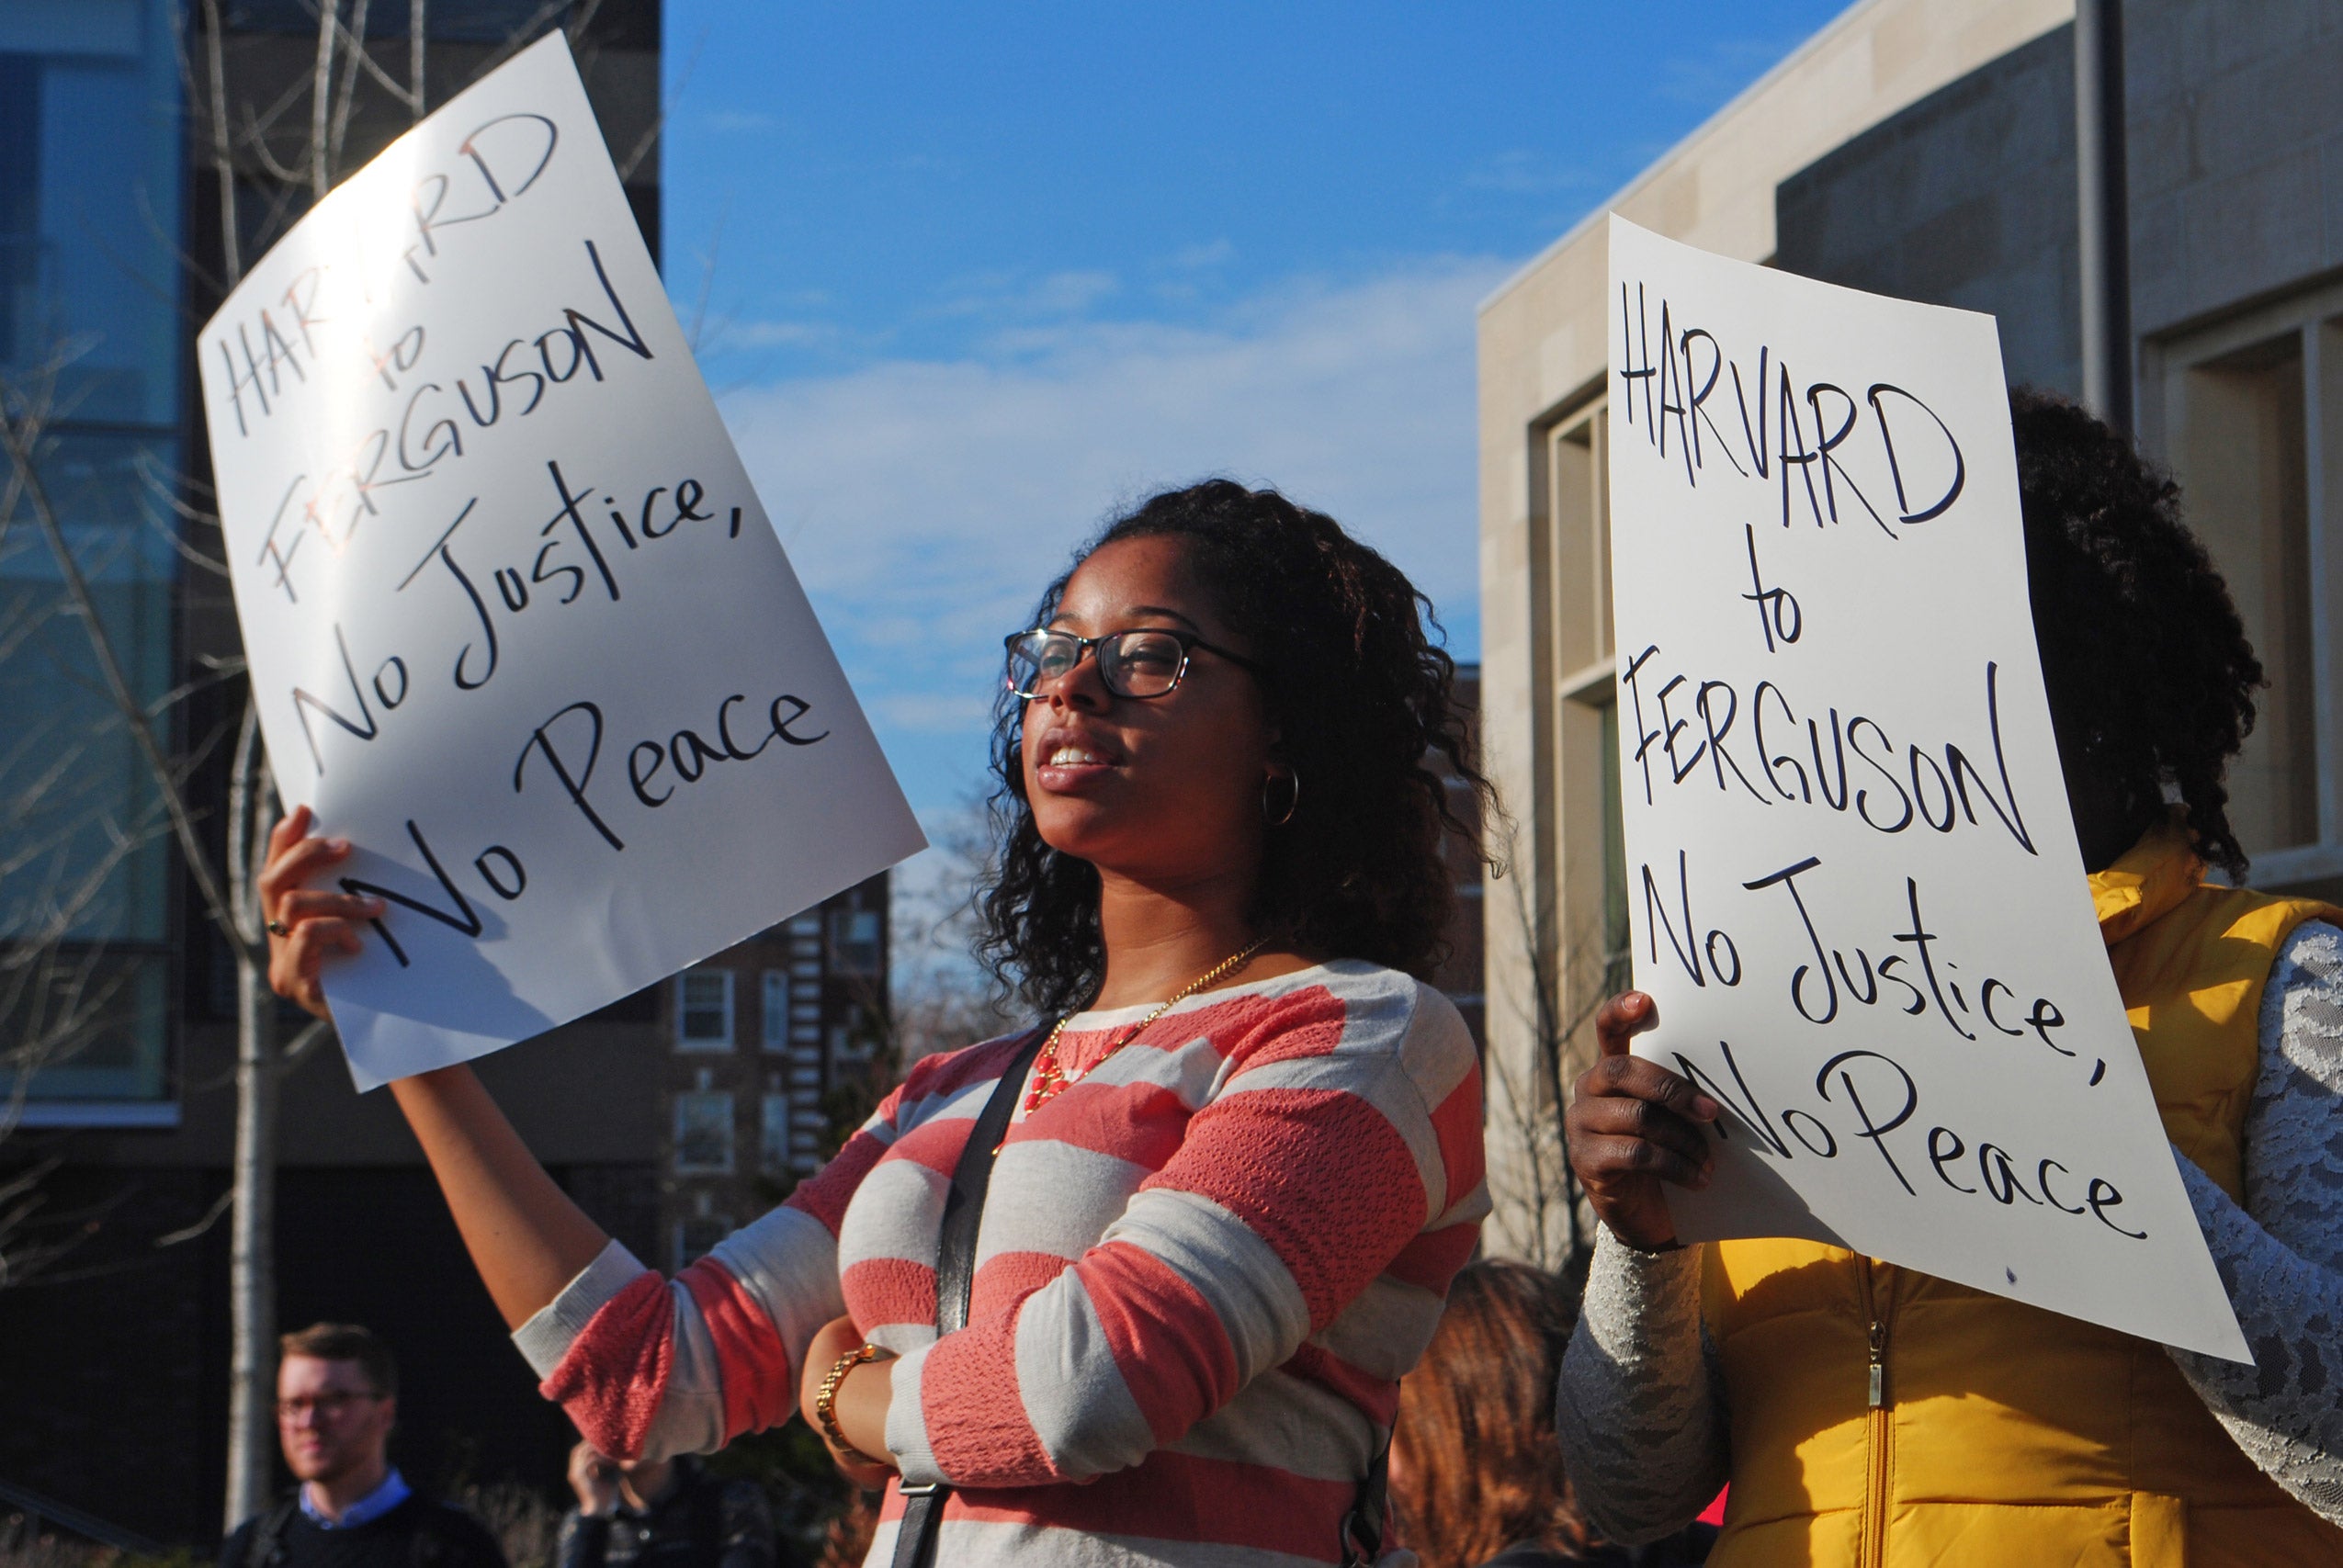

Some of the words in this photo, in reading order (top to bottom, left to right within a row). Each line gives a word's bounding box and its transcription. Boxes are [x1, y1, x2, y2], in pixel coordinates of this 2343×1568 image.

[219, 113, 558, 437] HARRD
[364, 325, 425, 391] to
[257, 240, 655, 604] FERGUSON
[1620, 281, 1965, 541] HARVARD
[292, 622, 411, 777] No
[396, 459, 743, 691] Justice,
[1742, 524, 1802, 653] to
[338, 818, 528, 969] No
[514, 693, 832, 852] Peace
[1623, 645, 2038, 857] FERGUSON
[1641, 850, 1741, 987] No
[1742, 856, 2106, 1088] Justice,
[1670, 1041, 1837, 1159] No
[1816, 1049, 2148, 1241] Peace
